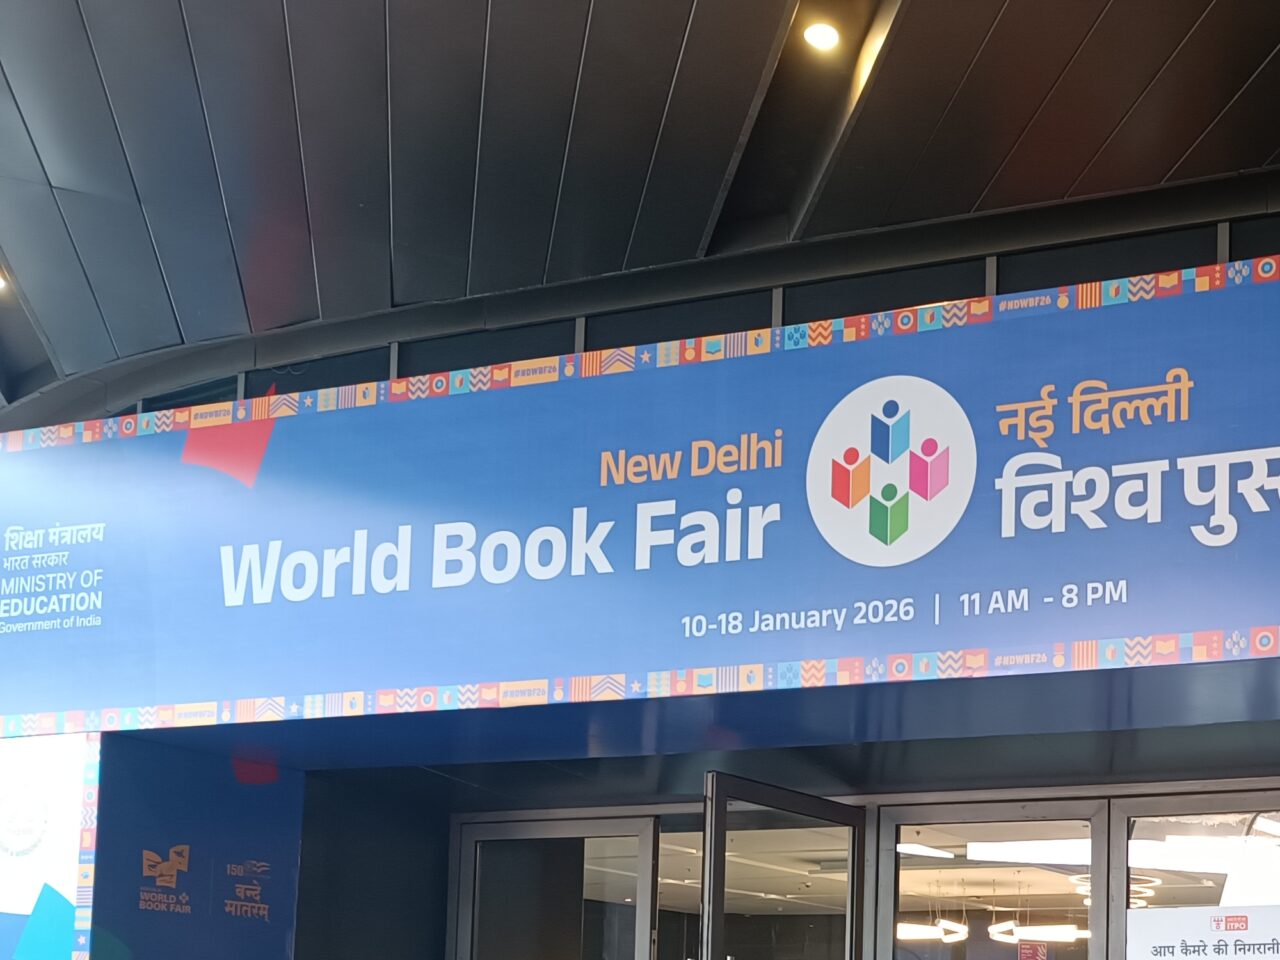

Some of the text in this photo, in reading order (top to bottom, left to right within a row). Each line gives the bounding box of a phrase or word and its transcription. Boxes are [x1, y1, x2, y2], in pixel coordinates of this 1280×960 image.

[995, 367, 1194, 447] नई दिल्ली
[600, 428, 783, 487] New Delhi
[994, 451, 1170, 538] विश्व
[4, 521, 106, 551] शिक्षा मंत्रालय
[219, 487, 781, 607] World Book Fair
[3, 551, 69, 571] भारत सरकार
[0, 569, 103, 595] MINISTRY OF
[0, 591, 102, 618] EDUCATION
[681, 611, 743, 638] 10-18
[748, 603, 846, 634] January
[853, 597, 915, 625] 2026
[959, 593, 981, 616] 11
[987, 588, 1029, 614] AM
[1061, 583, 1078, 609] 8
[1086, 580, 1128, 606] PM
[0, 613, 102, 634] Government of India
[227, 864, 244, 876] 150
[140, 891, 176, 903] WORLD
[235, 880, 260, 901] वन्दे
[139, 901, 191, 914] BOOK FAIR
[224, 899, 270, 922] मातरम्
[1151, 945, 1175, 957] आप
[1180, 939, 1208, 957] कैमरे
[1212, 939, 1228, 956] की
[1234, 938, 1280, 955] निगरानी
